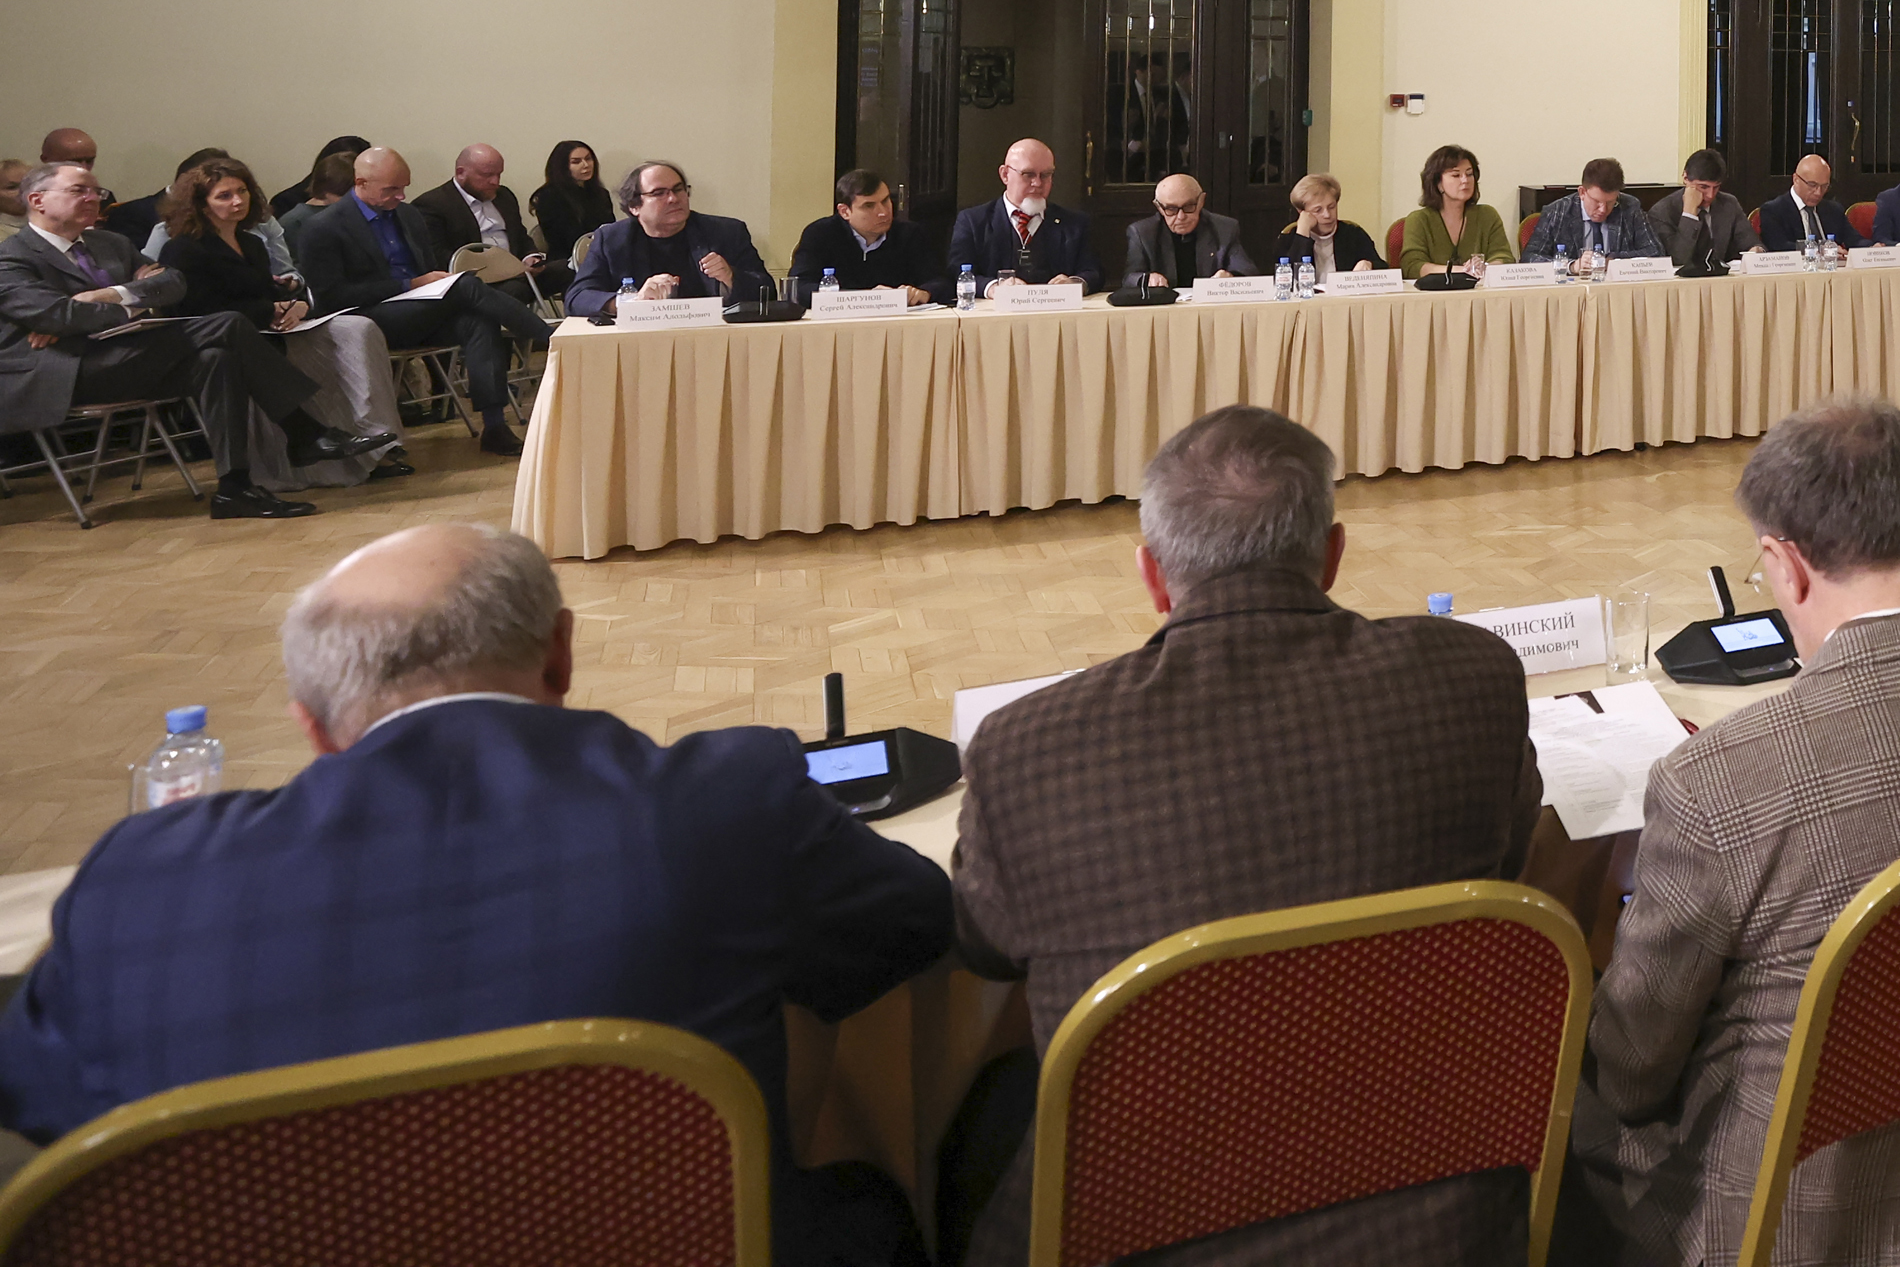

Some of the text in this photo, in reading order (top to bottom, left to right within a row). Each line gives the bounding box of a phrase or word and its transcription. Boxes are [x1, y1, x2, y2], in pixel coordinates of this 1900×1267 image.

[836, 294, 882, 303] ШАРГУНОВ
[629, 314, 661, 323] Максим
[1492, 611, 1575, 639] ВИНСКИЙ
[1512, 639, 1580, 658] адимович
